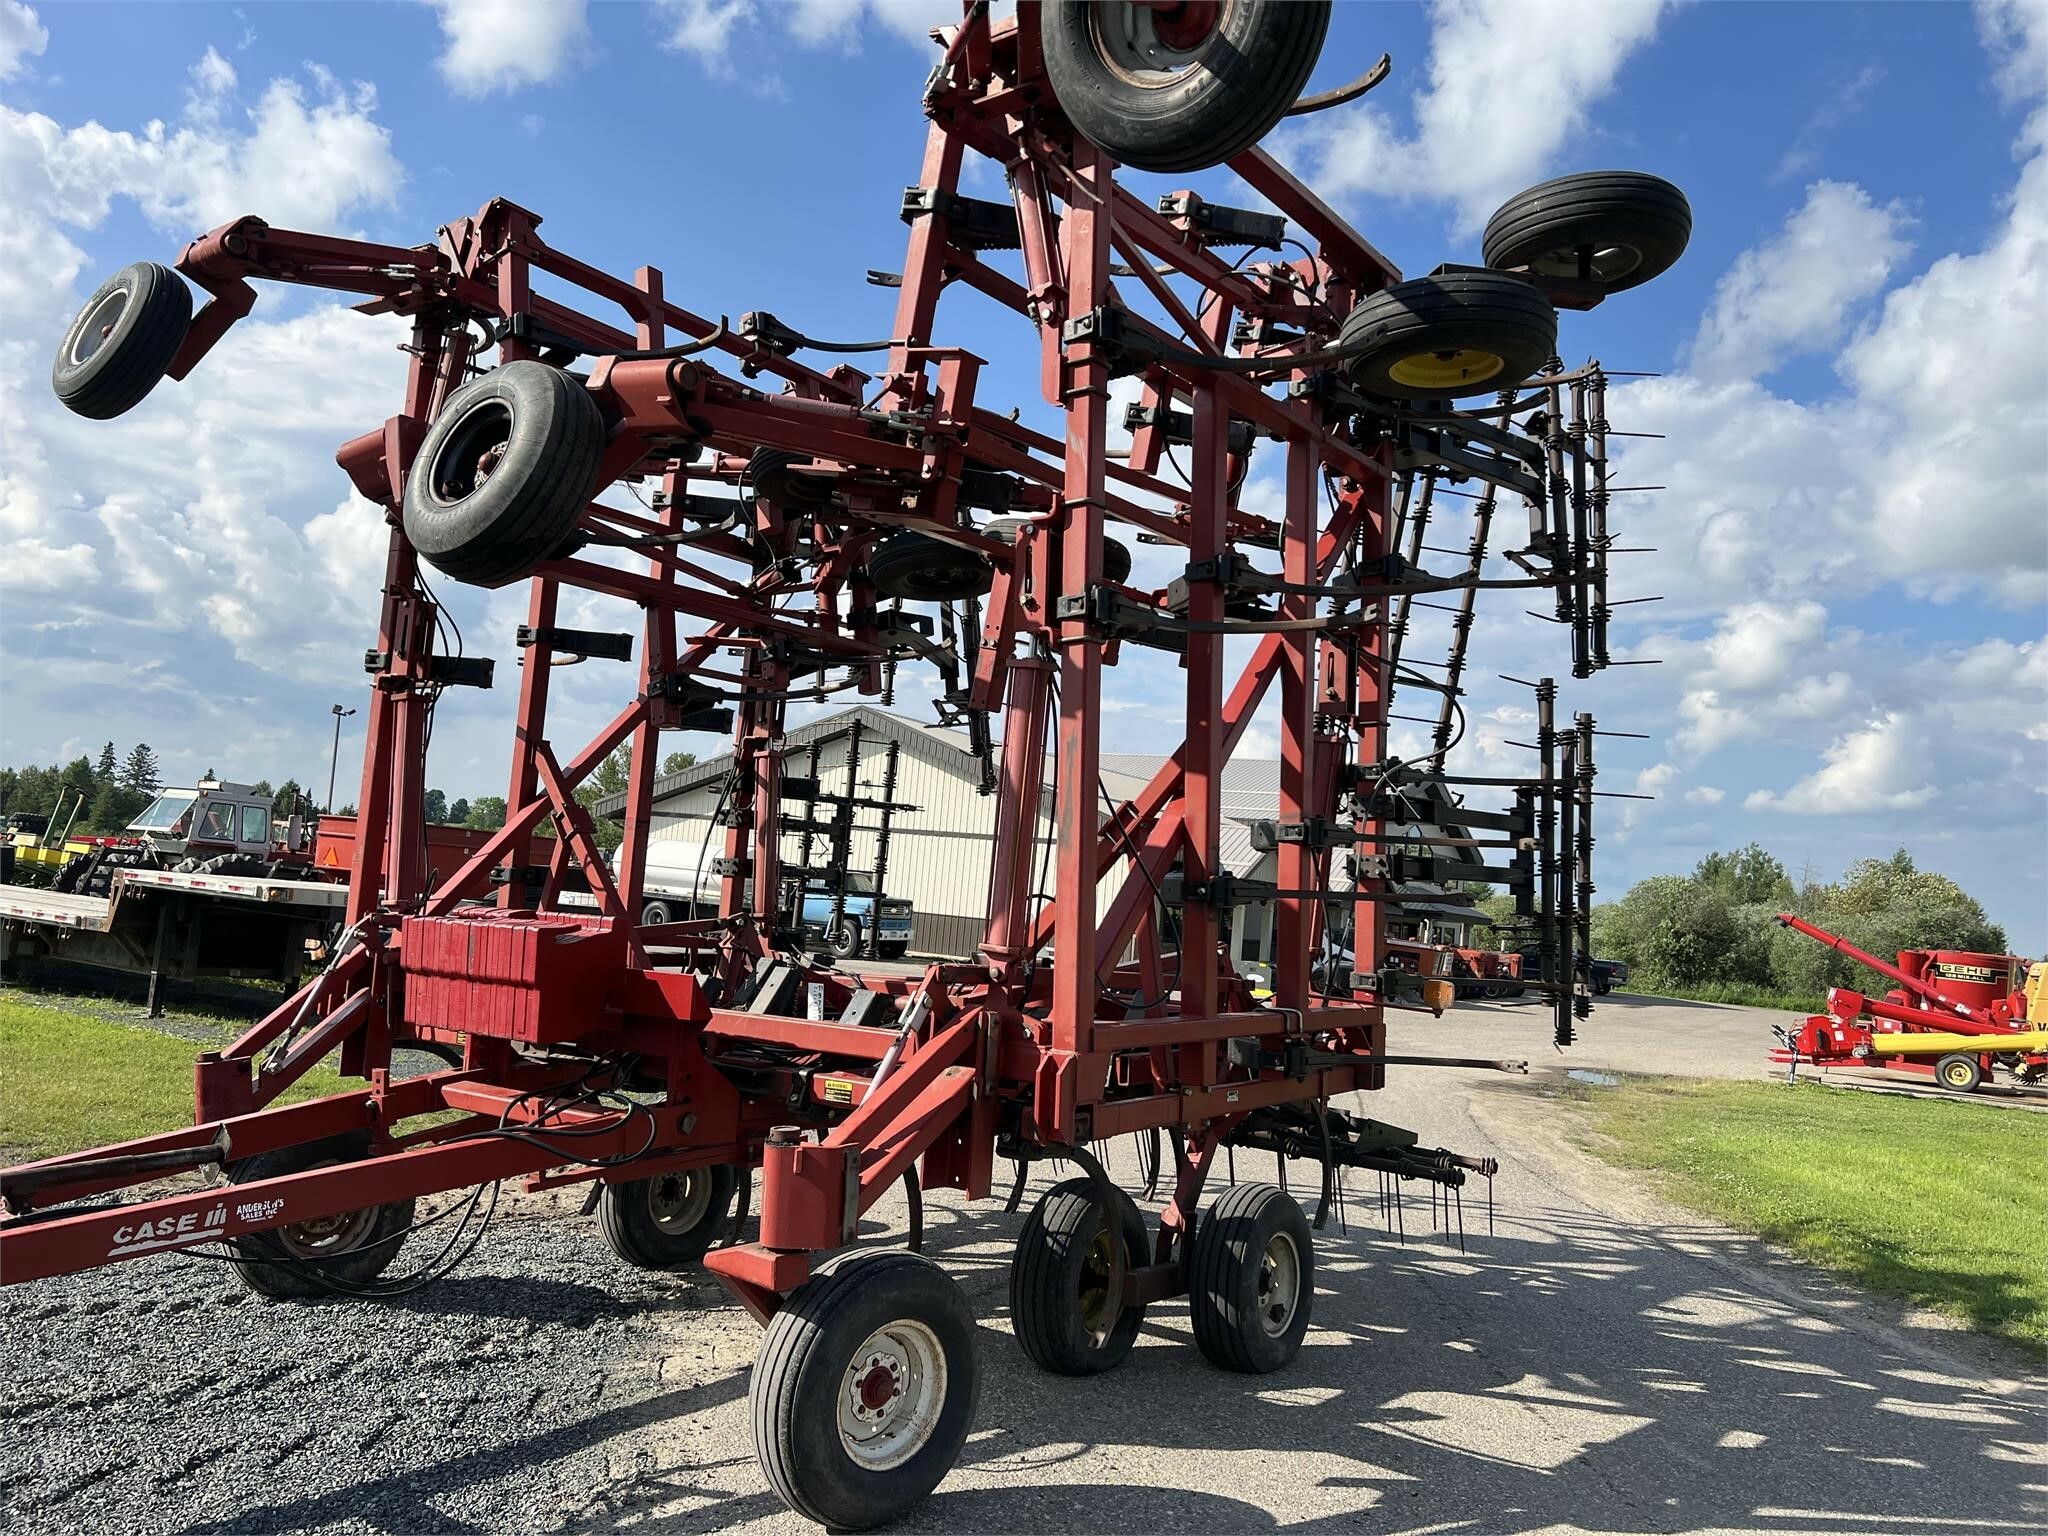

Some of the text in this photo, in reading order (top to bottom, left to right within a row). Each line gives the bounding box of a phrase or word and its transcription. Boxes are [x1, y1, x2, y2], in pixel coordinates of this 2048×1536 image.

[1941, 964, 1990, 976] GEHL
[240, 1210, 263, 1220] SALES
[265, 1207, 278, 1216] INC
[112, 1212, 199, 1244] CASE
